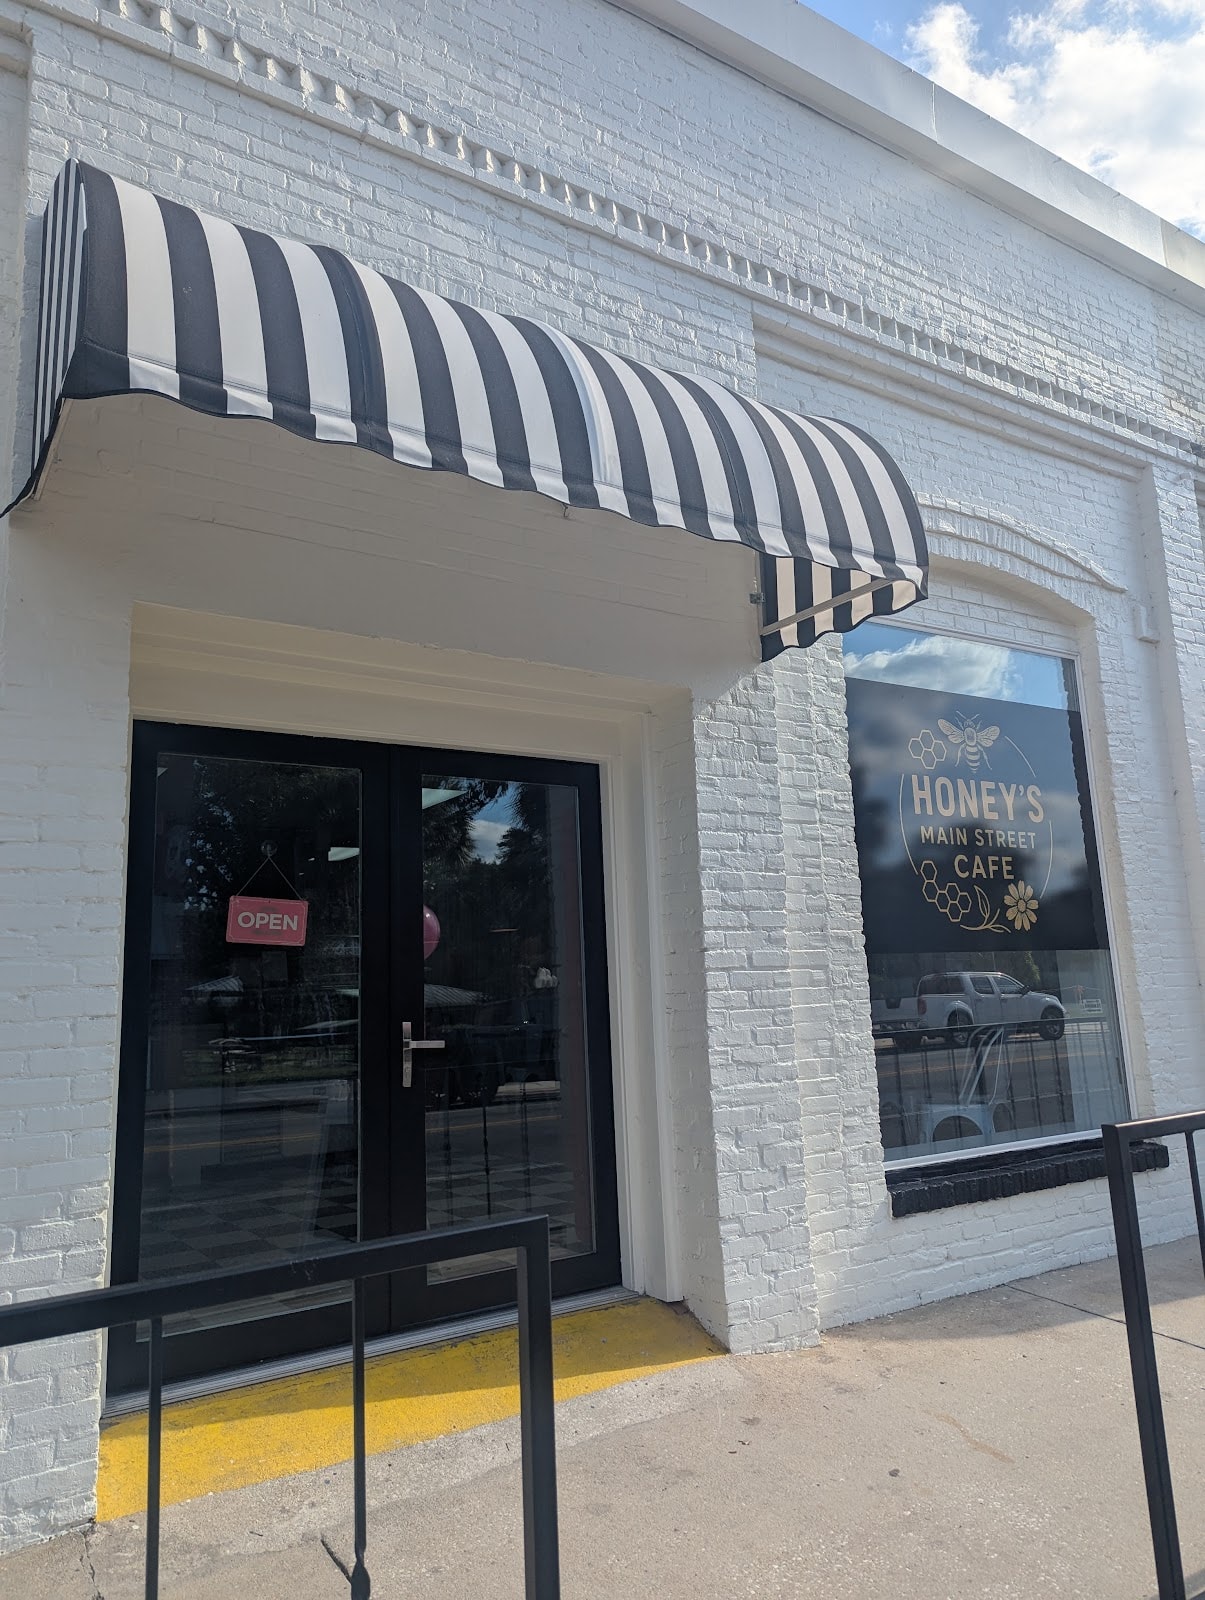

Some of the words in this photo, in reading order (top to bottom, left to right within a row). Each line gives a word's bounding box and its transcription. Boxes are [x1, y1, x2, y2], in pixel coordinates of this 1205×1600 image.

[912, 774, 1044, 823] HONEY'S
[921, 825, 968, 846] MAIN
[975, 829, 1036, 849] STREET
[954, 854, 1015, 880] CAFE
[237, 911, 299, 931] OPEN
